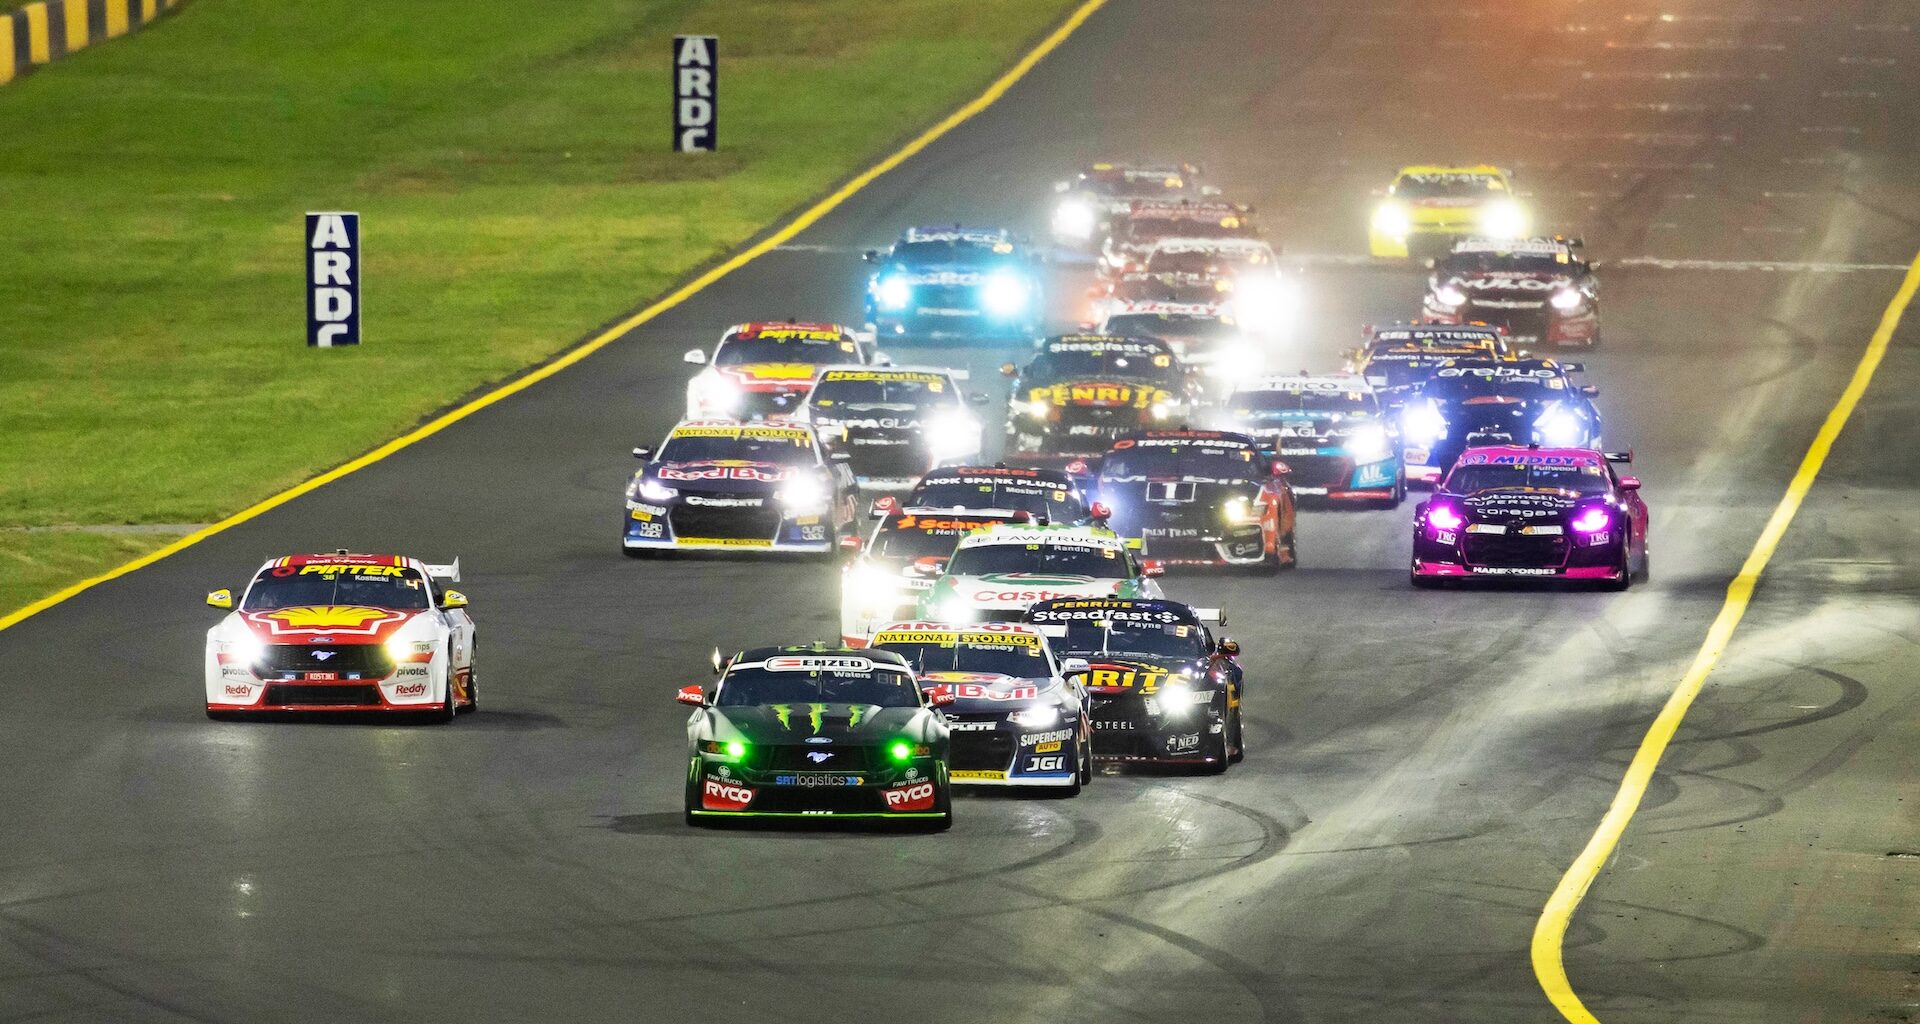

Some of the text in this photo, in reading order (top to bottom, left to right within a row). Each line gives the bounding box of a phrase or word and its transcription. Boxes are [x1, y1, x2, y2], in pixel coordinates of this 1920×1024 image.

[685, 420, 805, 429] AMOL
[1044, 536, 1118, 547] TRUCKS
[299, 564, 407, 577] PIRTEK
[1052, 601, 1132, 609] PENRITE
[1033, 610, 1152, 622] Steadfast
[887, 623, 1034, 633] AMOL
[1126, 621, 1162, 629] Payne
[879, 634, 1036, 645] NATIONAL STORAGE
[802, 659, 862, 668] ENZED
[834, 671, 871, 679] Waters
[225, 684, 252, 697] Reddy
[395, 683, 427, 696] Reddy
[1096, 721, 1135, 729] STEEL
[1037, 743, 1059, 751] AUTO
[1026, 756, 1064, 771] JGI
[705, 781, 753, 804] RYCO
[885, 783, 934, 806] RYCO
